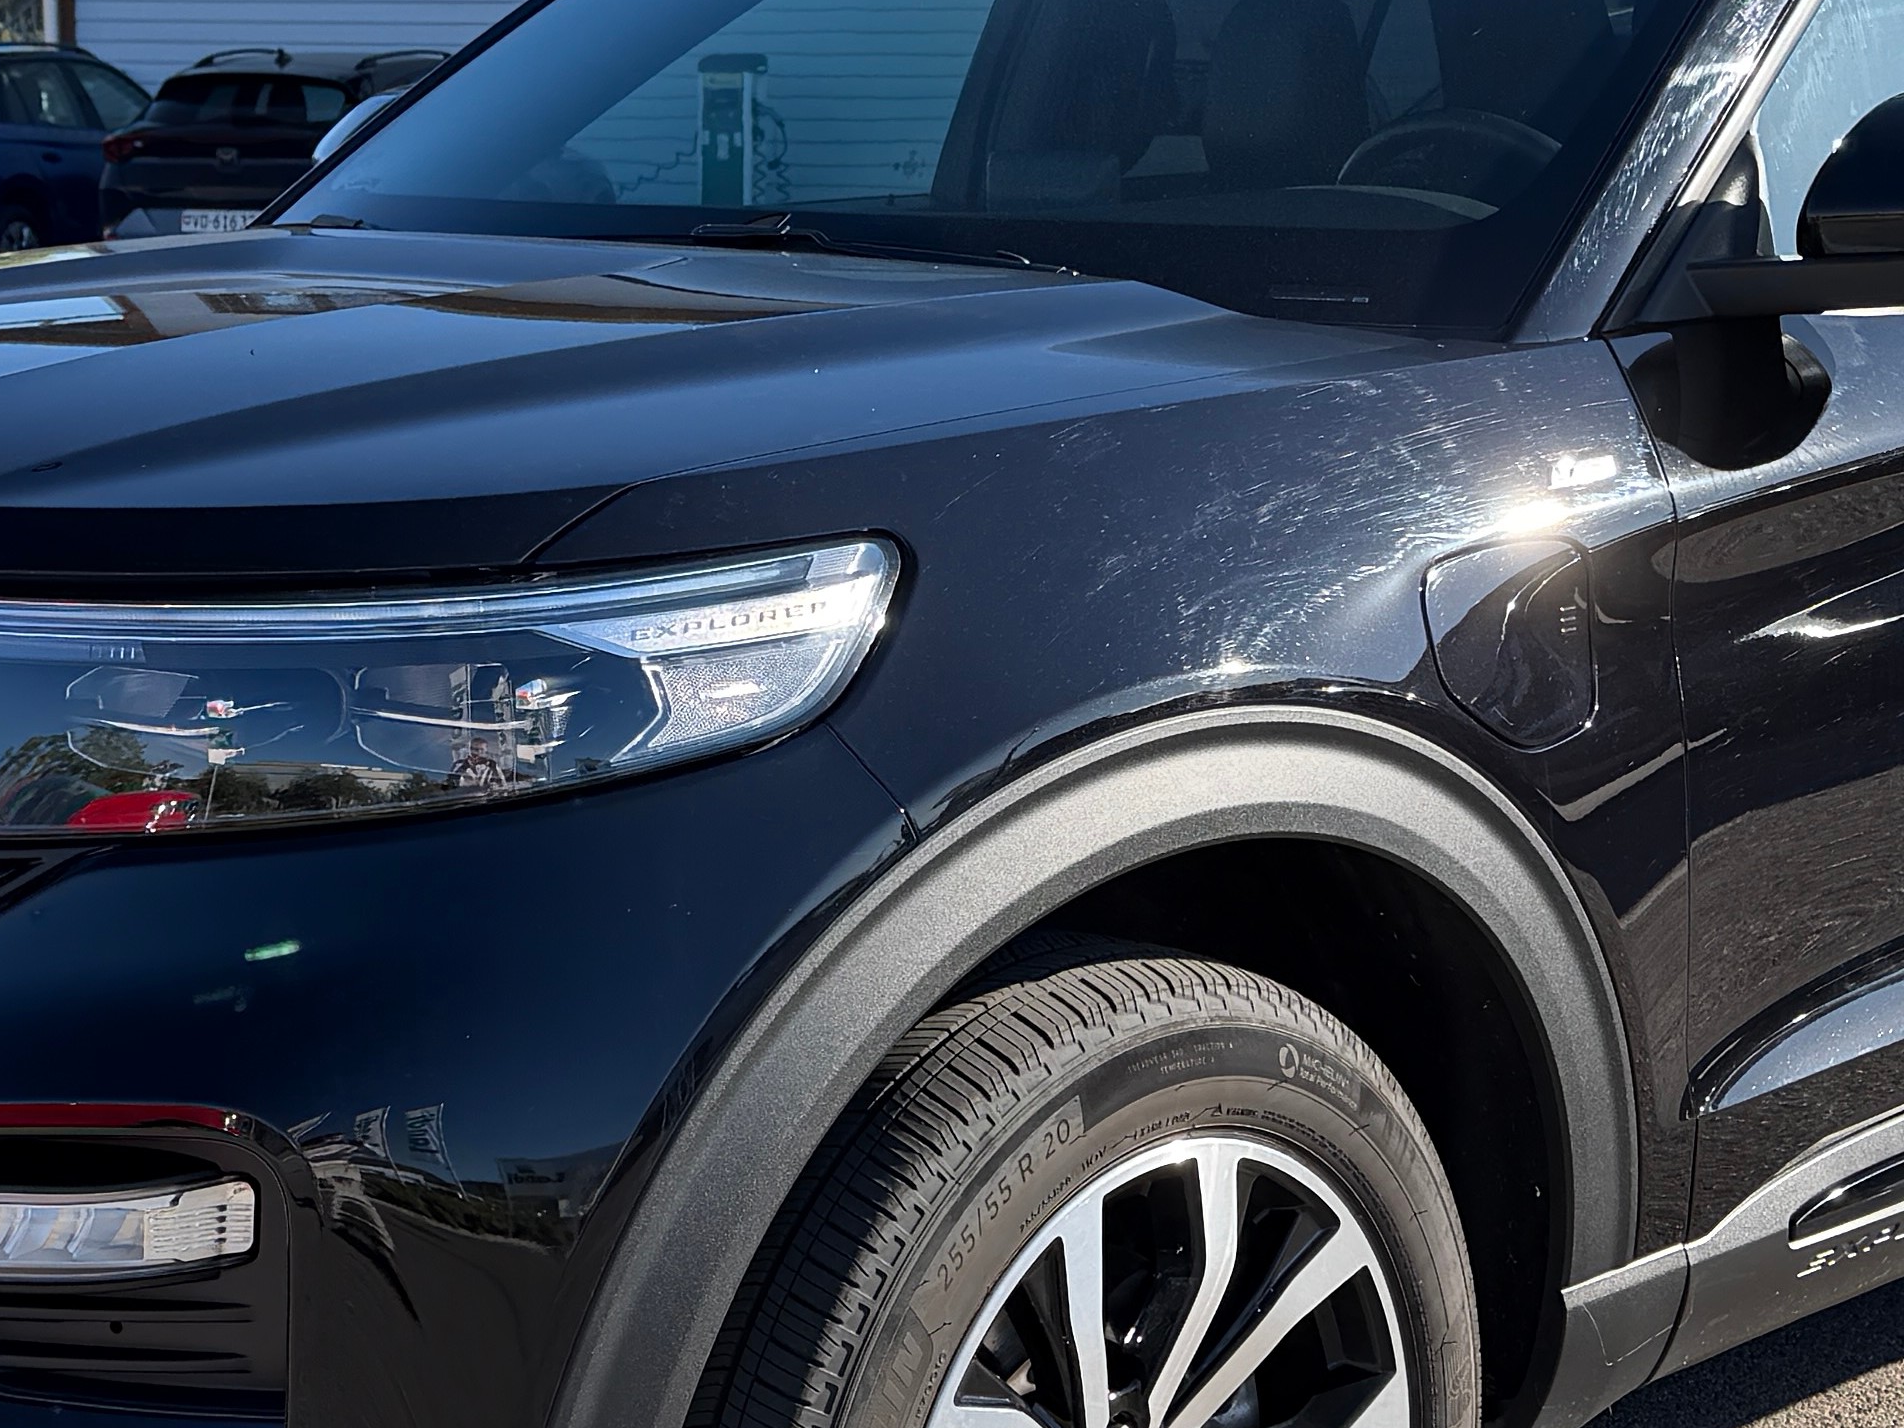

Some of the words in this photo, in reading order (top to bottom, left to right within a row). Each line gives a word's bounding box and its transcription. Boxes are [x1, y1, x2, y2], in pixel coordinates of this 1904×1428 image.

[630, 600, 827, 642] EXPLORER
[937, 1175, 1013, 1292] 255/55
[1018, 1152, 1034, 1183] R
[1044, 1118, 1070, 1160] 20
